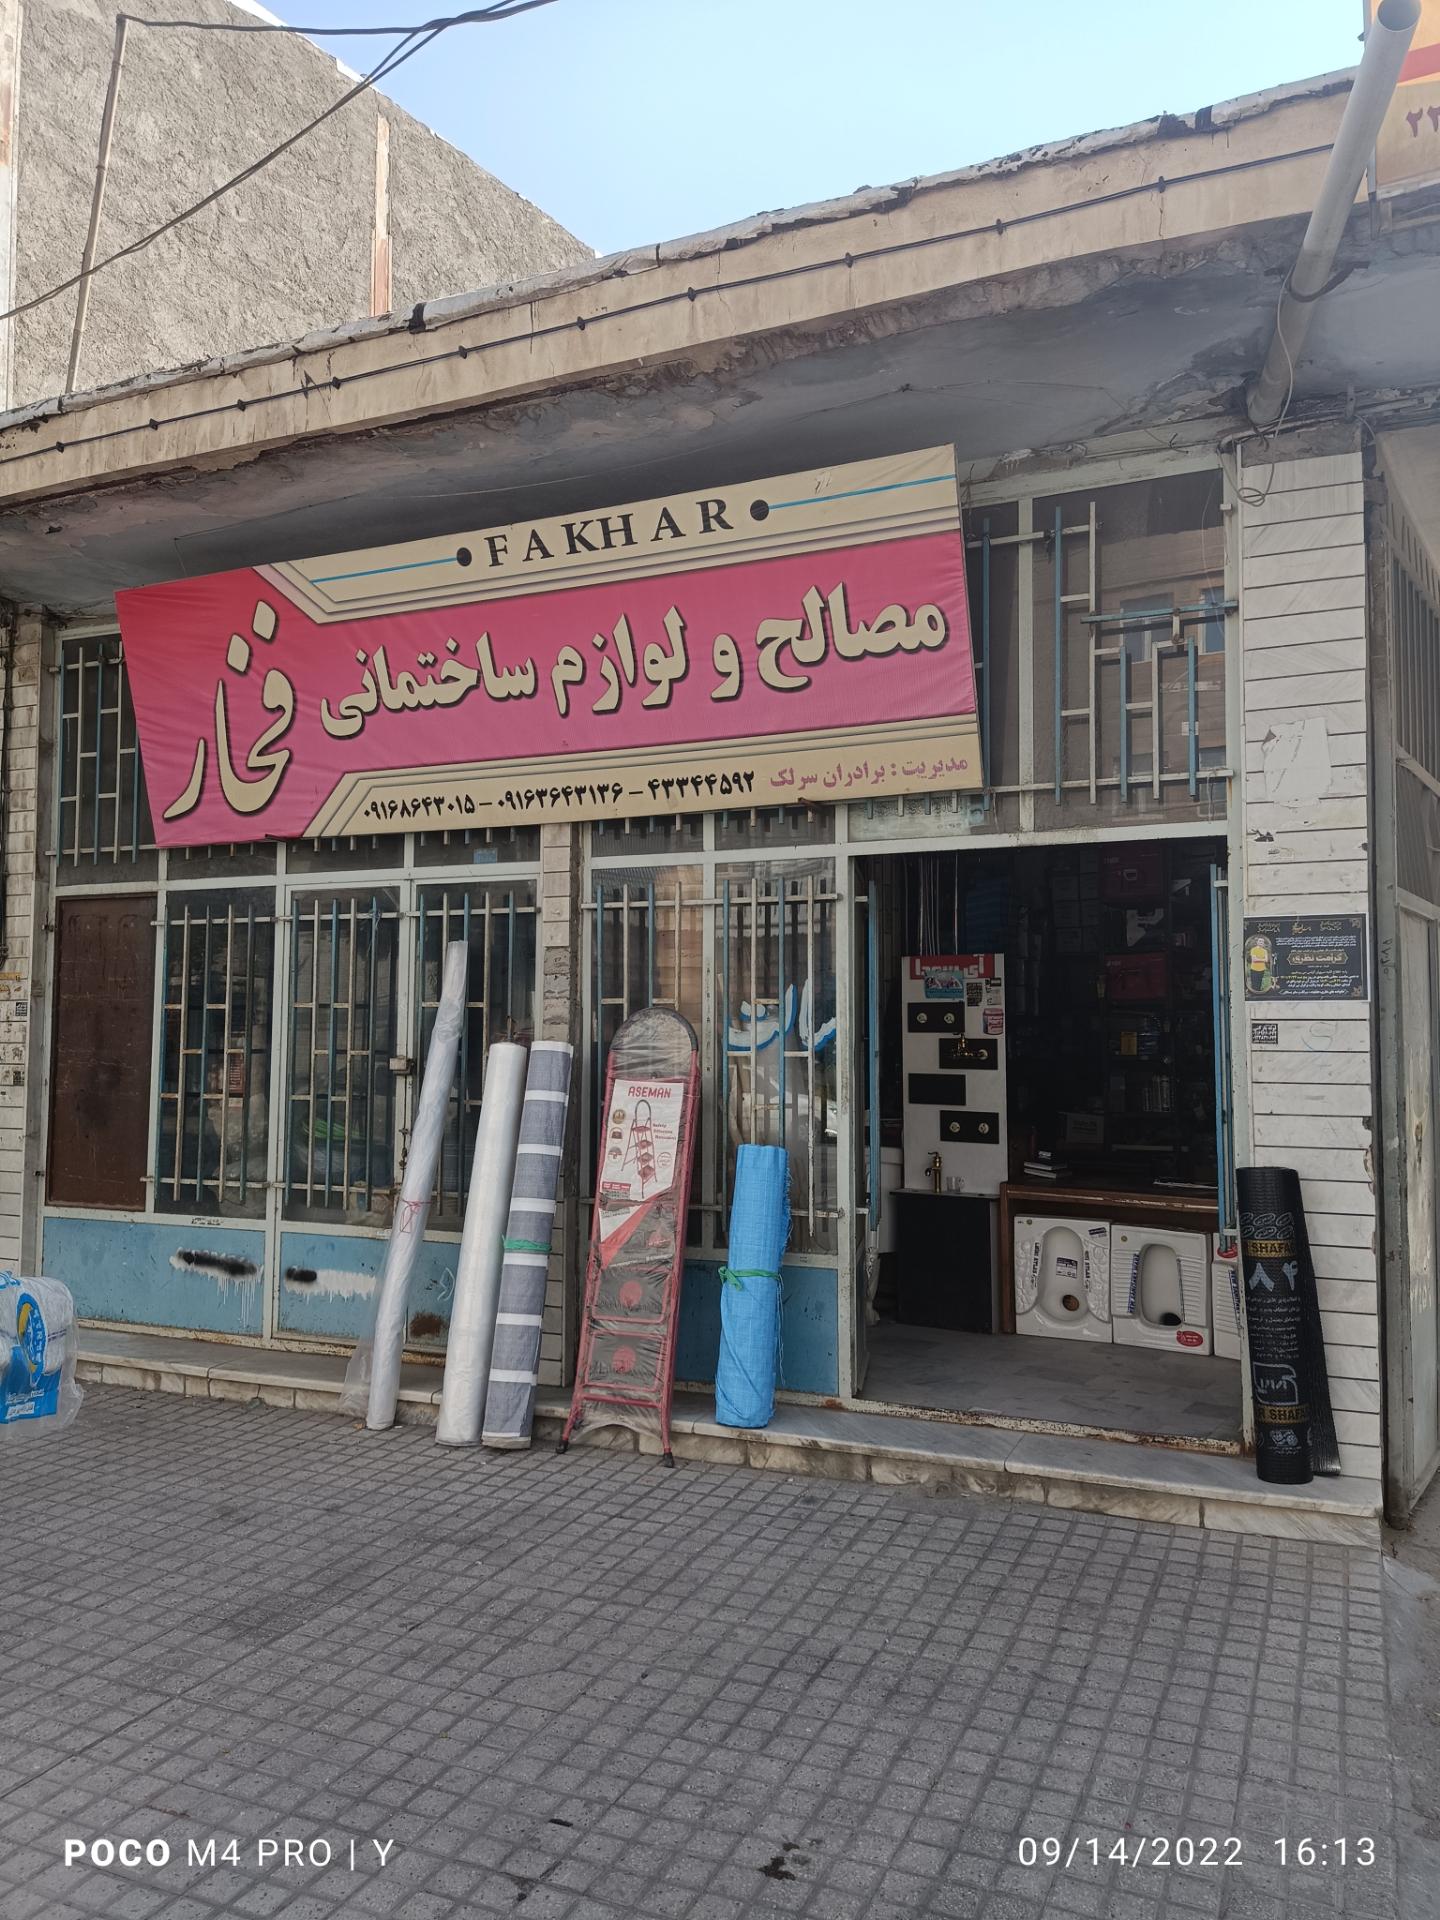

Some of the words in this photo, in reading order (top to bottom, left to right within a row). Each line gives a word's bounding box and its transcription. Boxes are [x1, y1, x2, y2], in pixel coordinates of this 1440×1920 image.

[483, 498, 734, 567] FAKHAR
[550, 604, 689, 718] لوازم
[710, 632, 743, 702] و
[756, 581, 950, 690] مصالح
[162, 599, 297, 823] فخار
[319, 630, 538, 740] ساختمانی
[363, 794, 476, 820] ۰۹۱۶۸۶۴۳۰۱۵
[497, 782, 624, 811] ۰۹۱۶۳۶۴۳۱۳۶
[647, 770, 755, 801] ۴۳۳۴۴۵۹۲
[822, 760, 886, 788] برادران
[627, 1086, 672, 1098] ASEMAN
